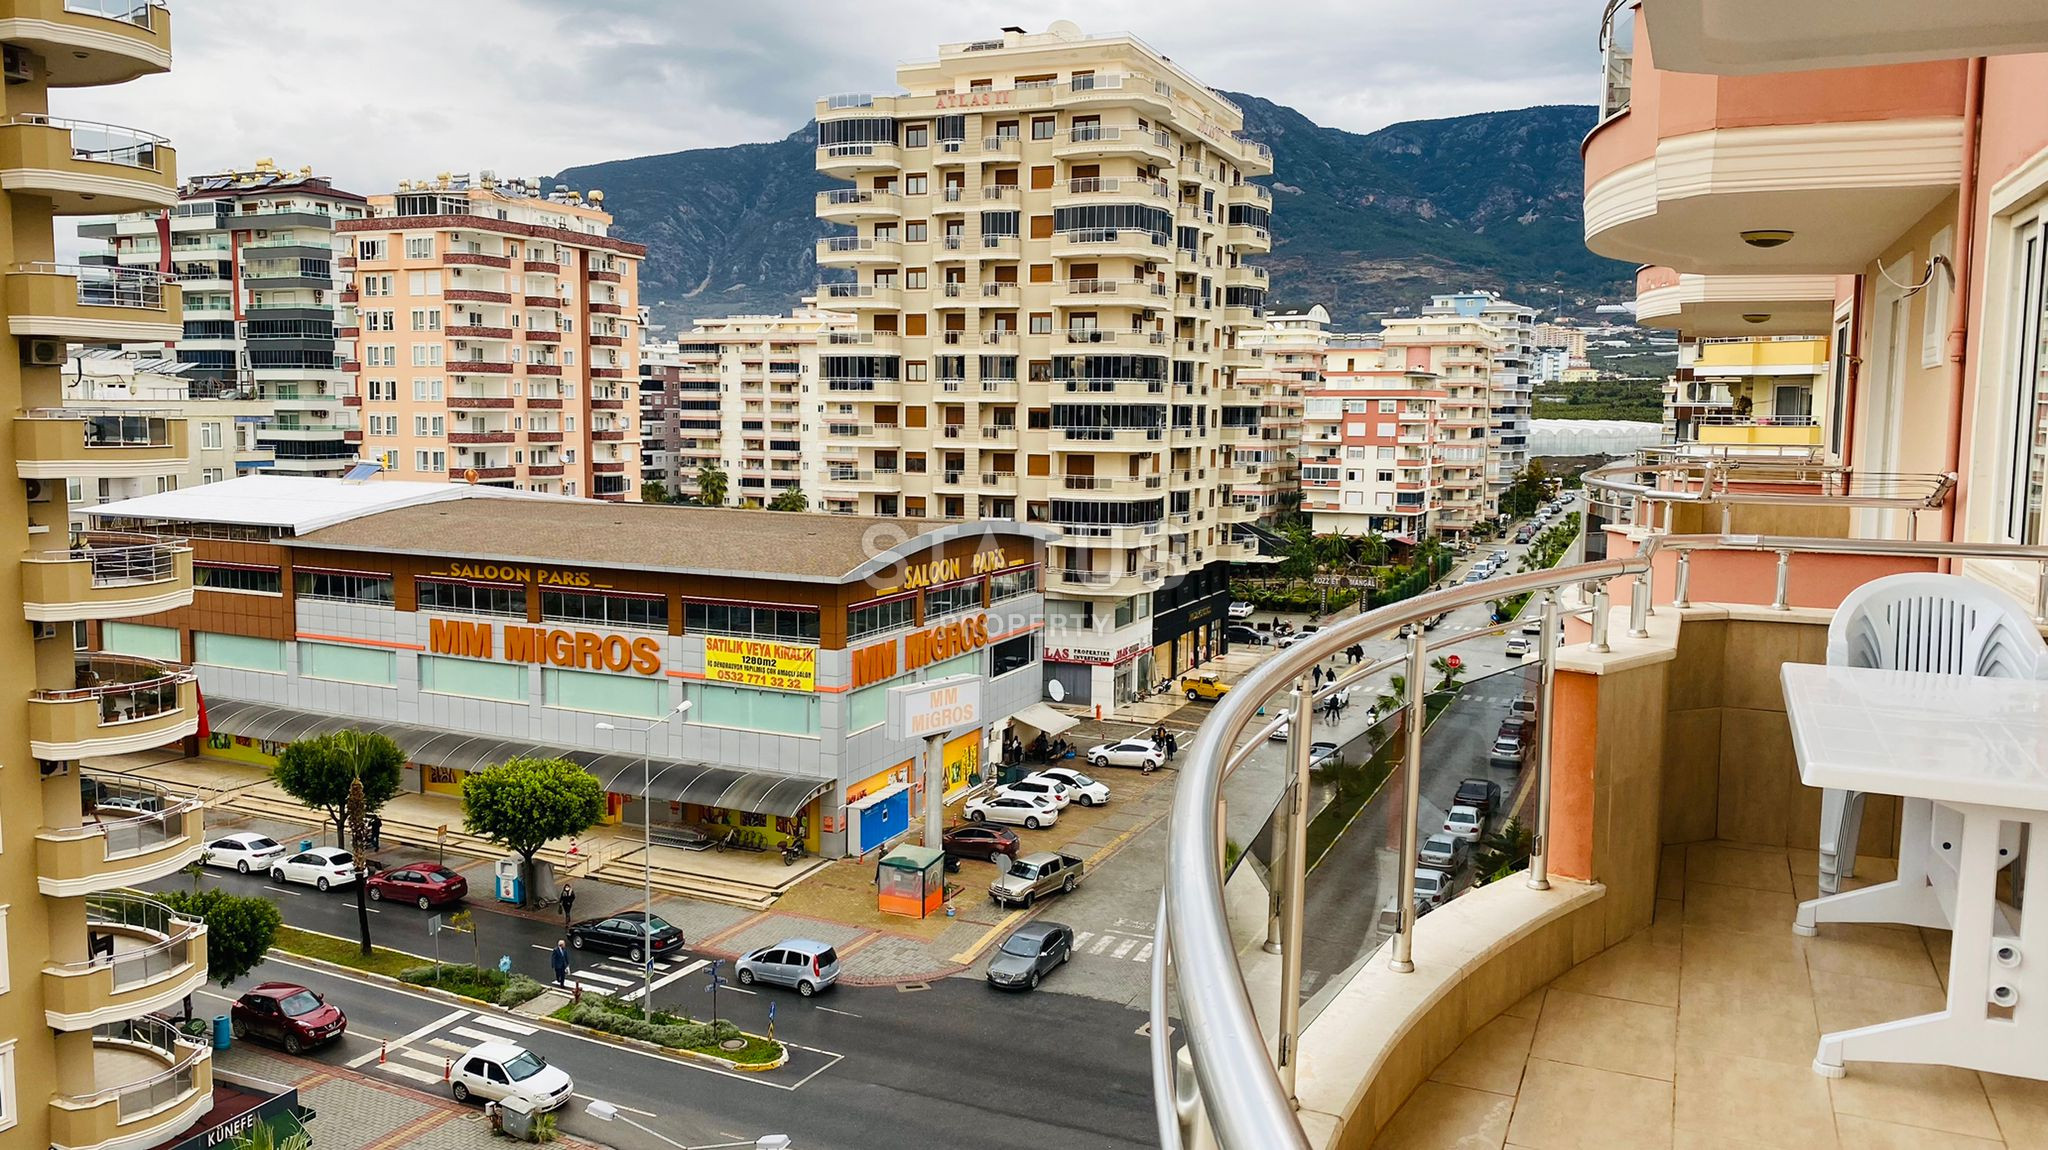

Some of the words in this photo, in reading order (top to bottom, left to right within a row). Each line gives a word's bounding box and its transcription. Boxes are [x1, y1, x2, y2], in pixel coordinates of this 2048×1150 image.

[936, 93, 989, 109] ATLAS
[995, 91, 1009, 104] II
[451, 563, 530, 583] SALOON
[904, 558, 960, 590] SALOON
[429, 618, 493, 659] MM
[706, 637, 743, 655] SATILIK
[746, 641, 771, 658] VEYA
[742, 656, 777, 667] 1280m2
[1073, 648, 1110, 657] PROPERTIES
[852, 639, 898, 689] MM
[717, 670, 744, 682] 0532
[747, 674, 766, 685] 771
[770, 676, 784, 687] 32
[787, 678, 801, 689] 32
[930, 687, 958, 708] MM
[208, 1114, 253, 1147] KÜNEFE
